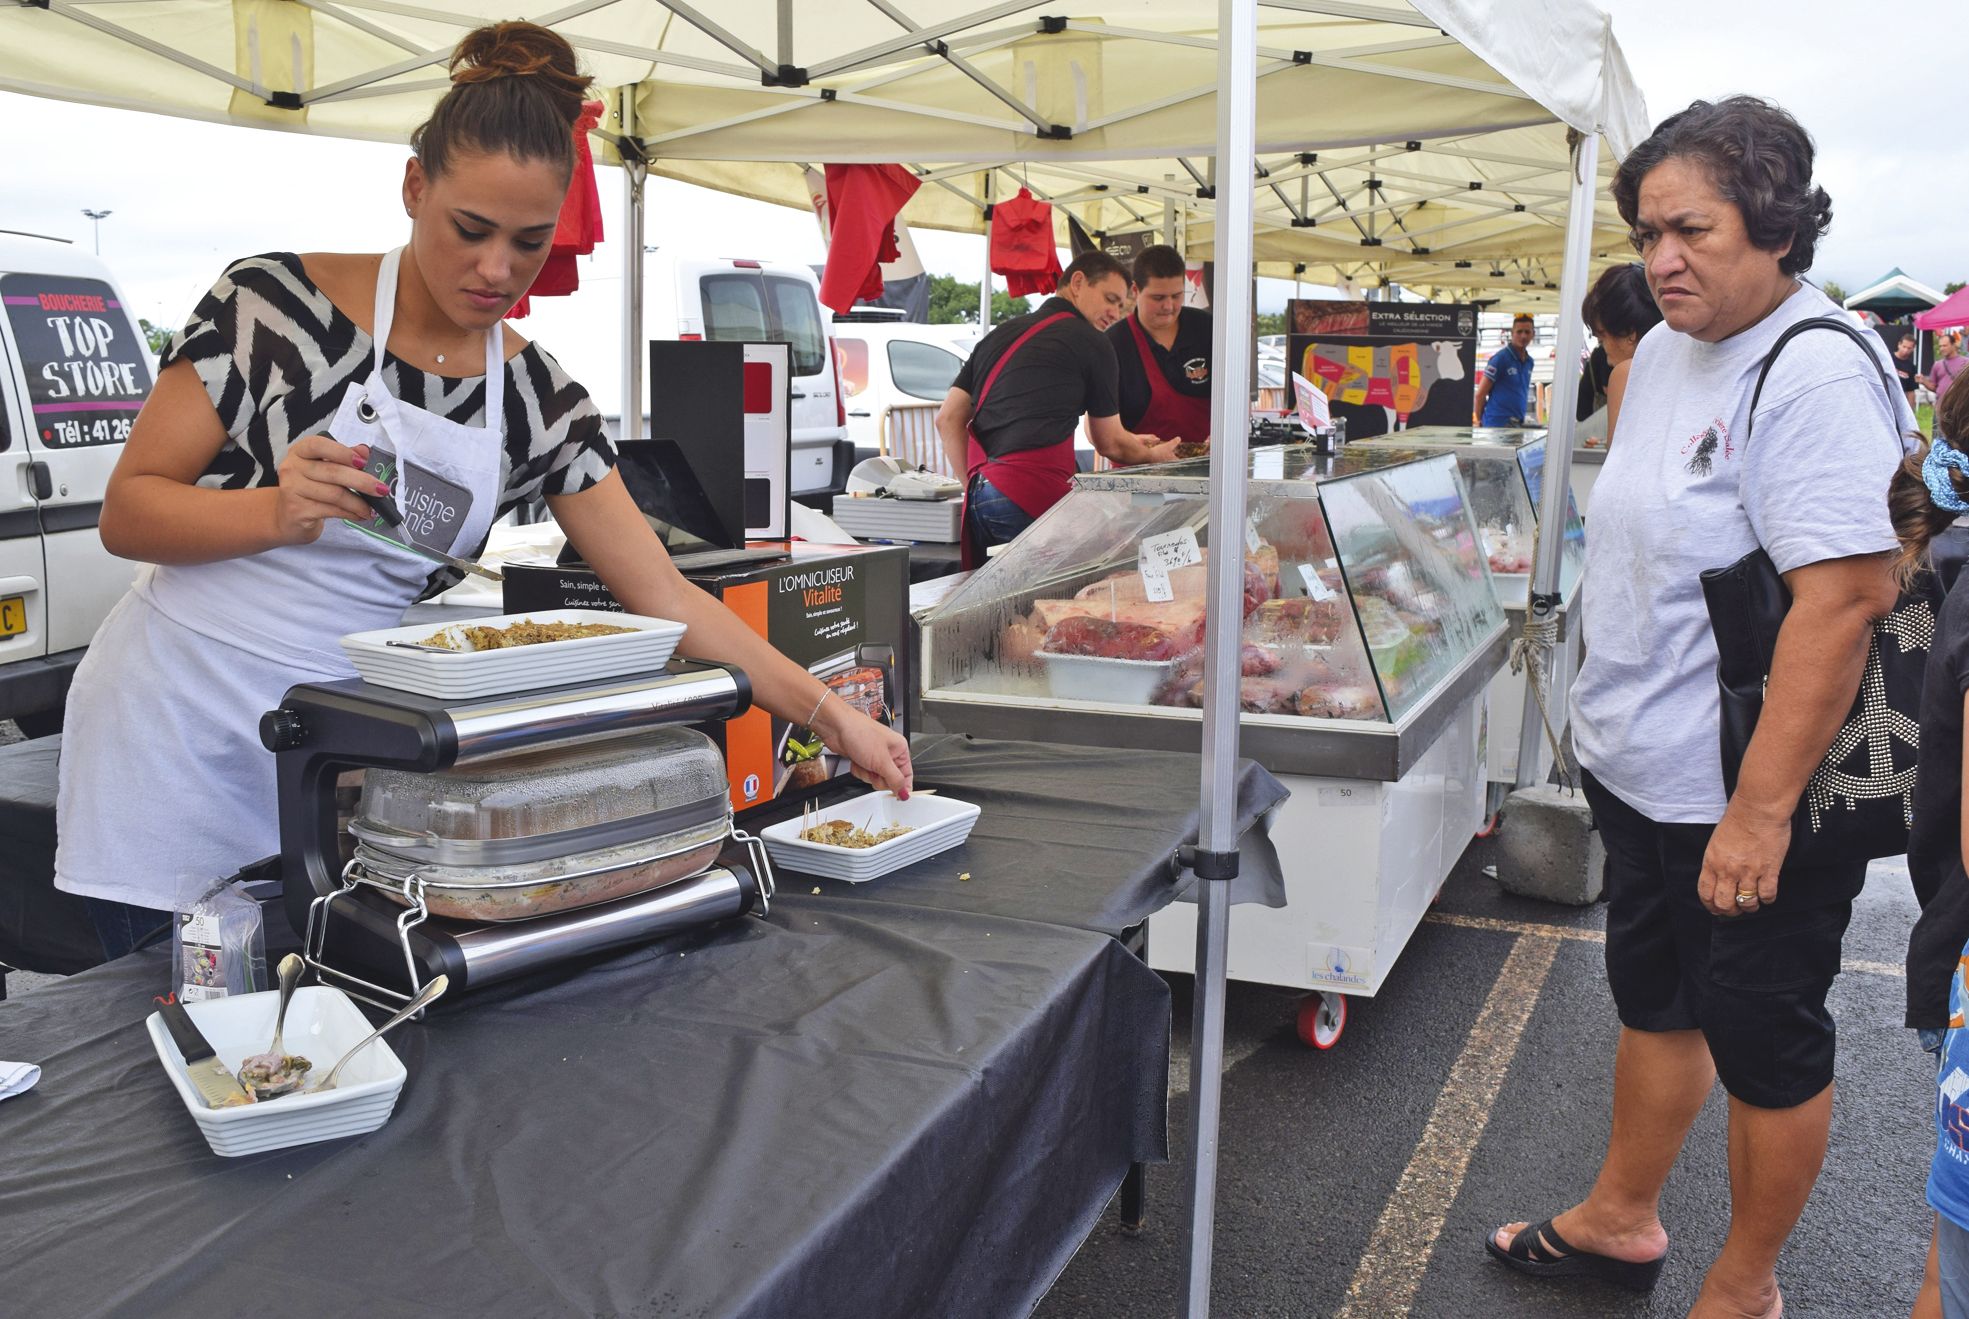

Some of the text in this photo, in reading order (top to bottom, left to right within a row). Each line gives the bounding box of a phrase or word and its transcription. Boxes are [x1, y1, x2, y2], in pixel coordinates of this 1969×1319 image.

[38, 292, 107, 313] BOUCHERIE
[1372, 310, 1451, 322] EXTRA SÉLECTION
[46, 316, 114, 358] TOP
[42, 360, 143, 398] STORE
[54, 419, 82, 444] Tél
[92, 419, 110, 442] 41
[112, 418, 130, 440] 26
[560, 579, 576, 590] Sain,
[577, 581, 600, 592] simple
[779, 565, 855, 593] L'OMNICUISEUR
[564, 597, 622, 608] Cuisinez votre san
[803, 583, 842, 608] Vitalité
[2, 604, 14, 631] C
[1340, 788, 1352, 797] 50
[195, 916, 205, 926] 50
